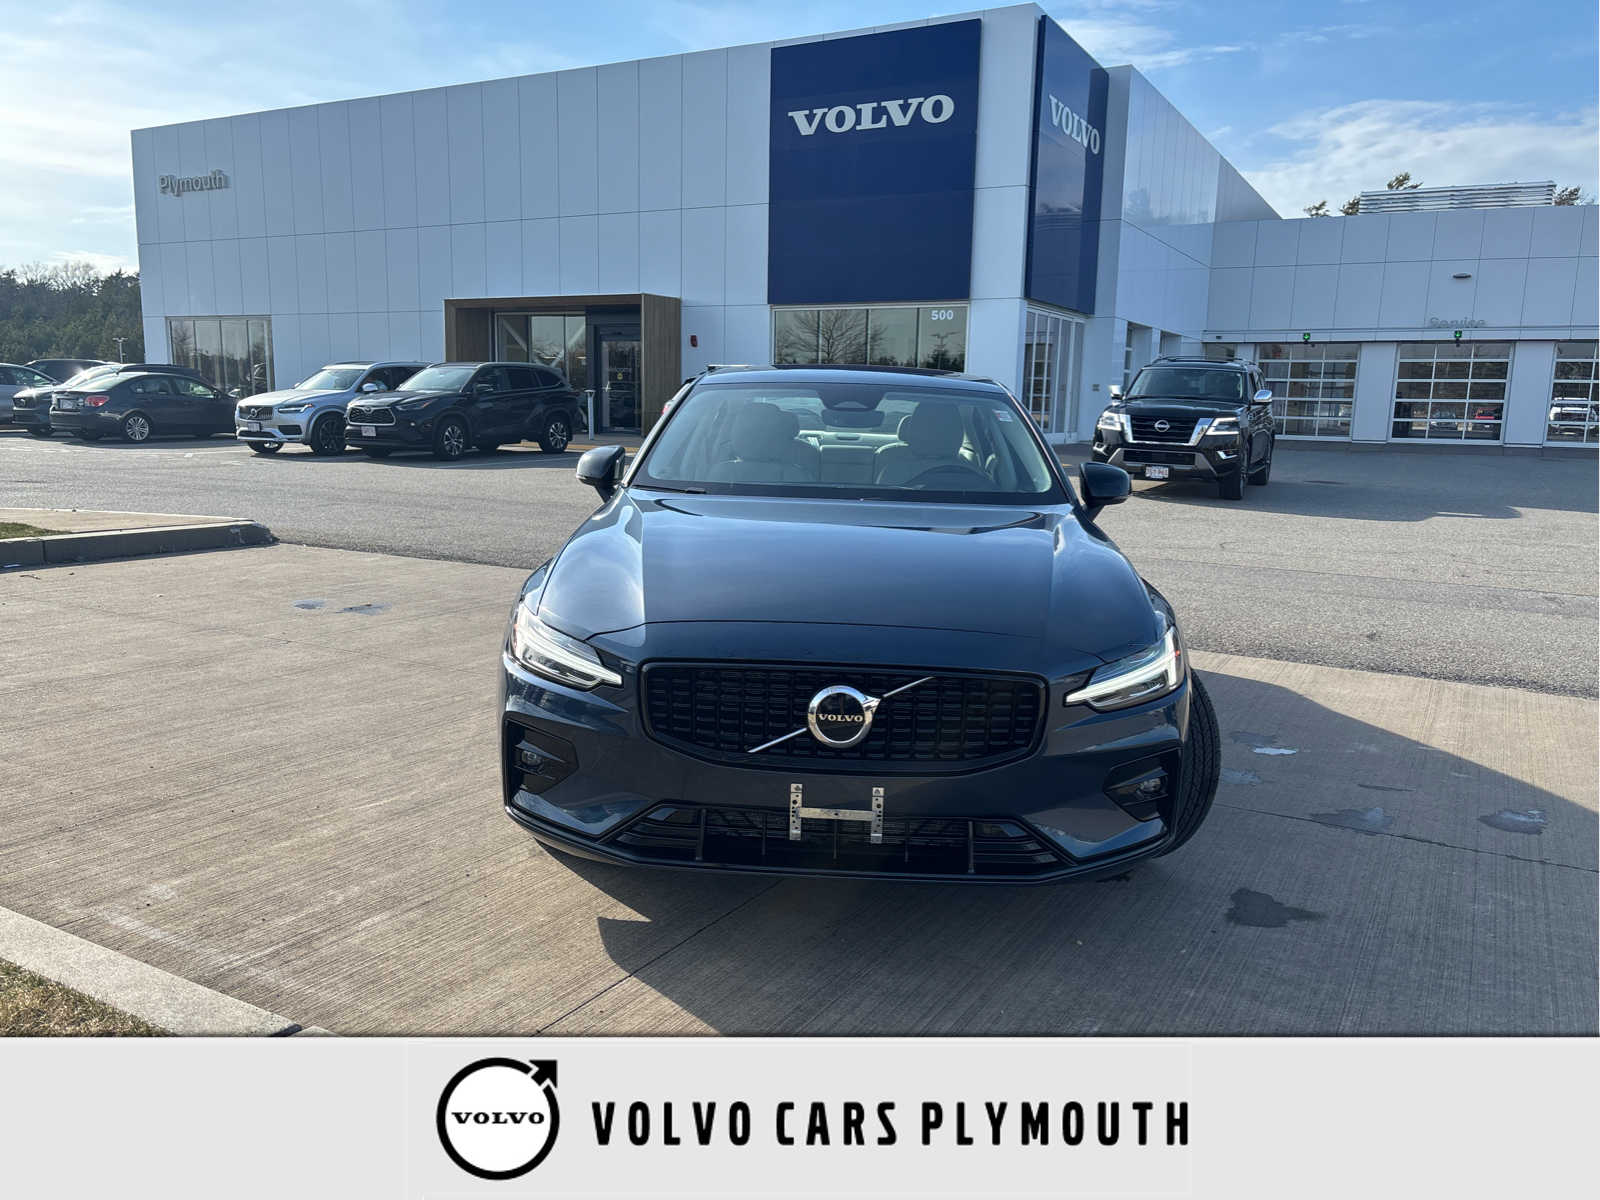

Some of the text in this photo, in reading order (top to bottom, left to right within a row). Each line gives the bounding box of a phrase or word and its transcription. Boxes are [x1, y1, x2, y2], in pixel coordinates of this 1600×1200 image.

[788, 94, 955, 136] VOLVO
[1049, 94, 1100, 155] VOLVO
[159, 168, 228, 197] Plymouth
[931, 310, 954, 320] 500
[817, 713, 863, 722] VOLVO
